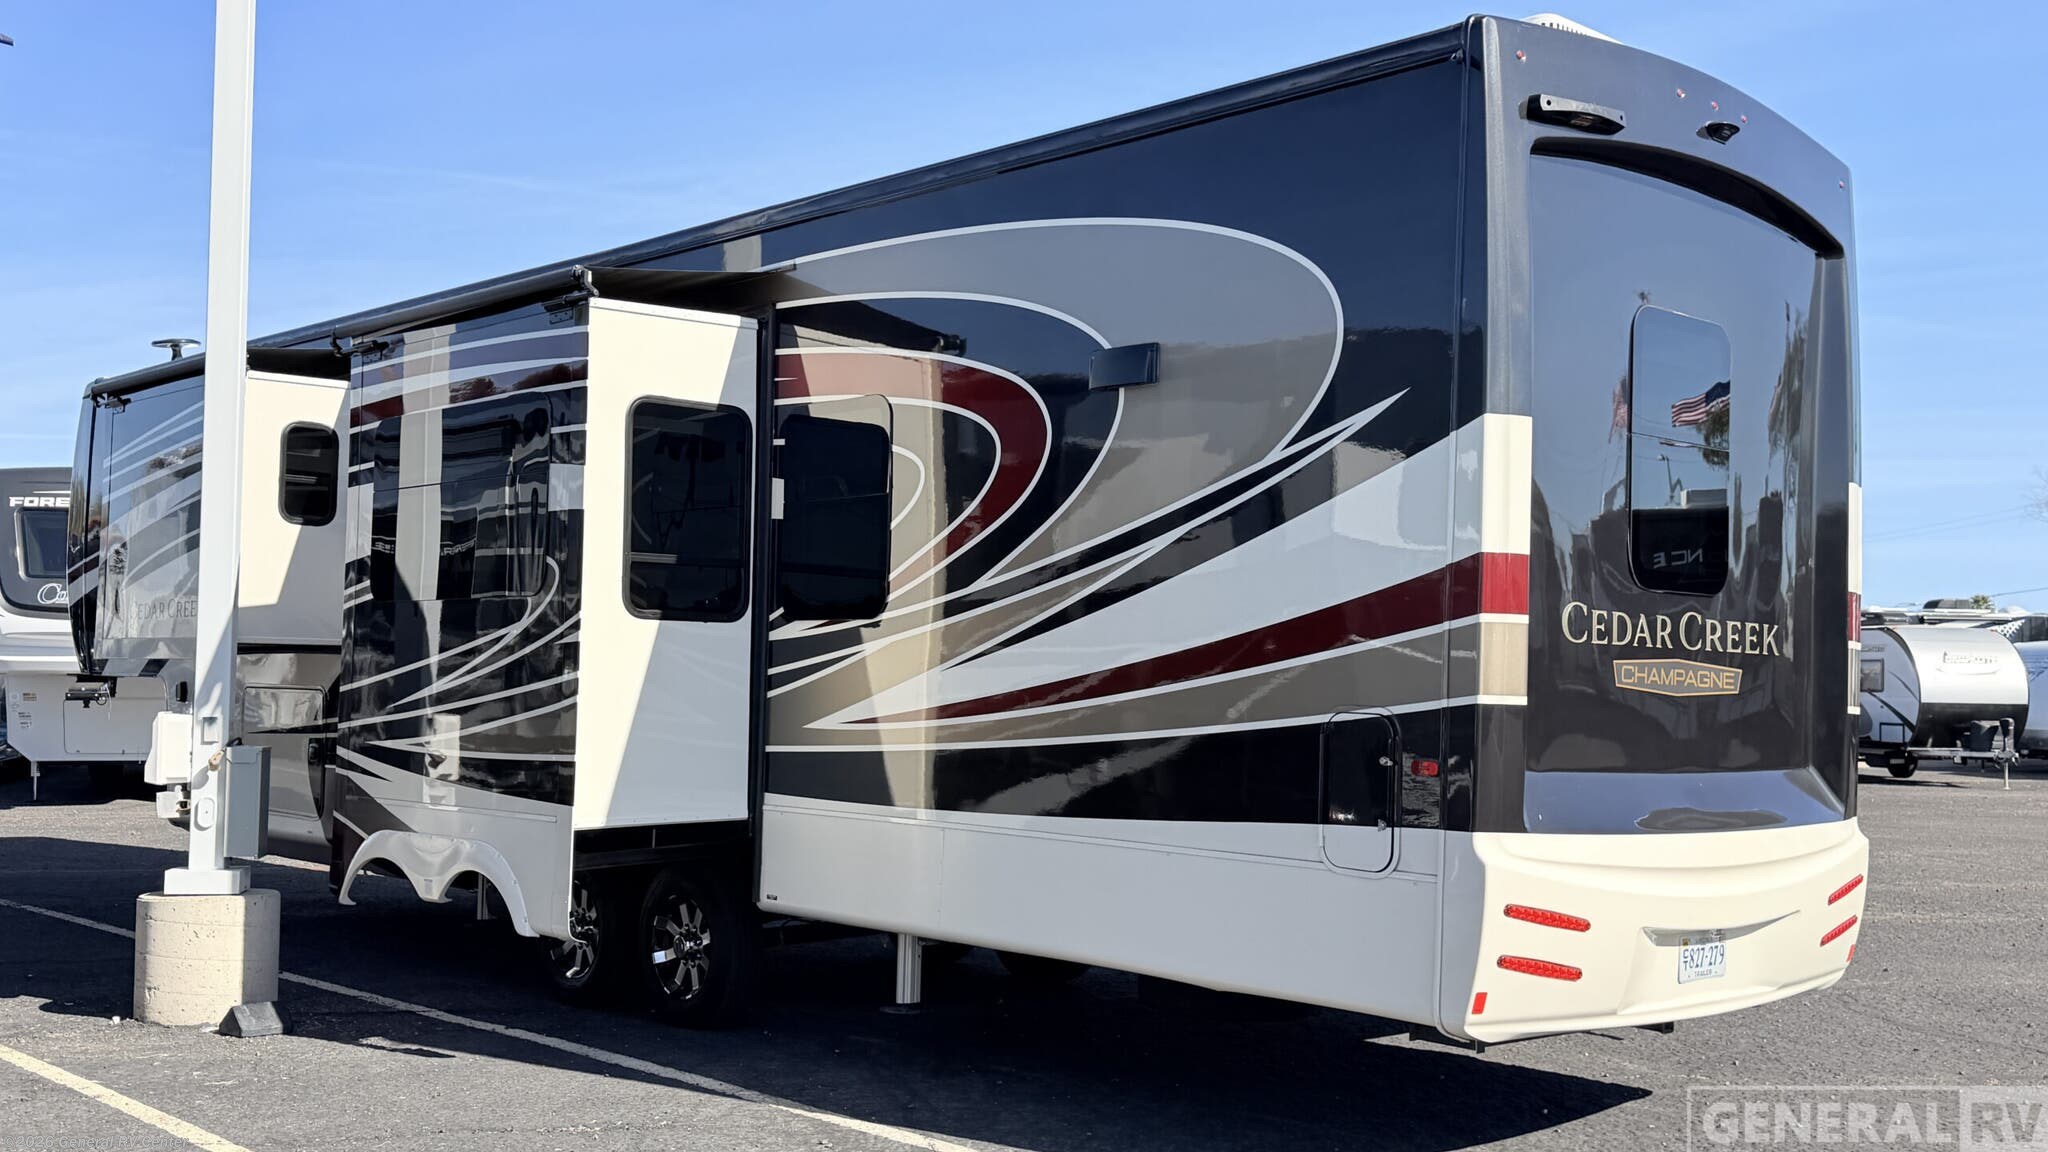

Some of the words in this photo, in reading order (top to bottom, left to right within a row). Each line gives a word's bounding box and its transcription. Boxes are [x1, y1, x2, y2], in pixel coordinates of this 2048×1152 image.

[1561, 601, 1673, 649] CEDAR
[1679, 611, 1780, 656] CREEK
[1620, 665, 1735, 689] CHAMPAGNE
